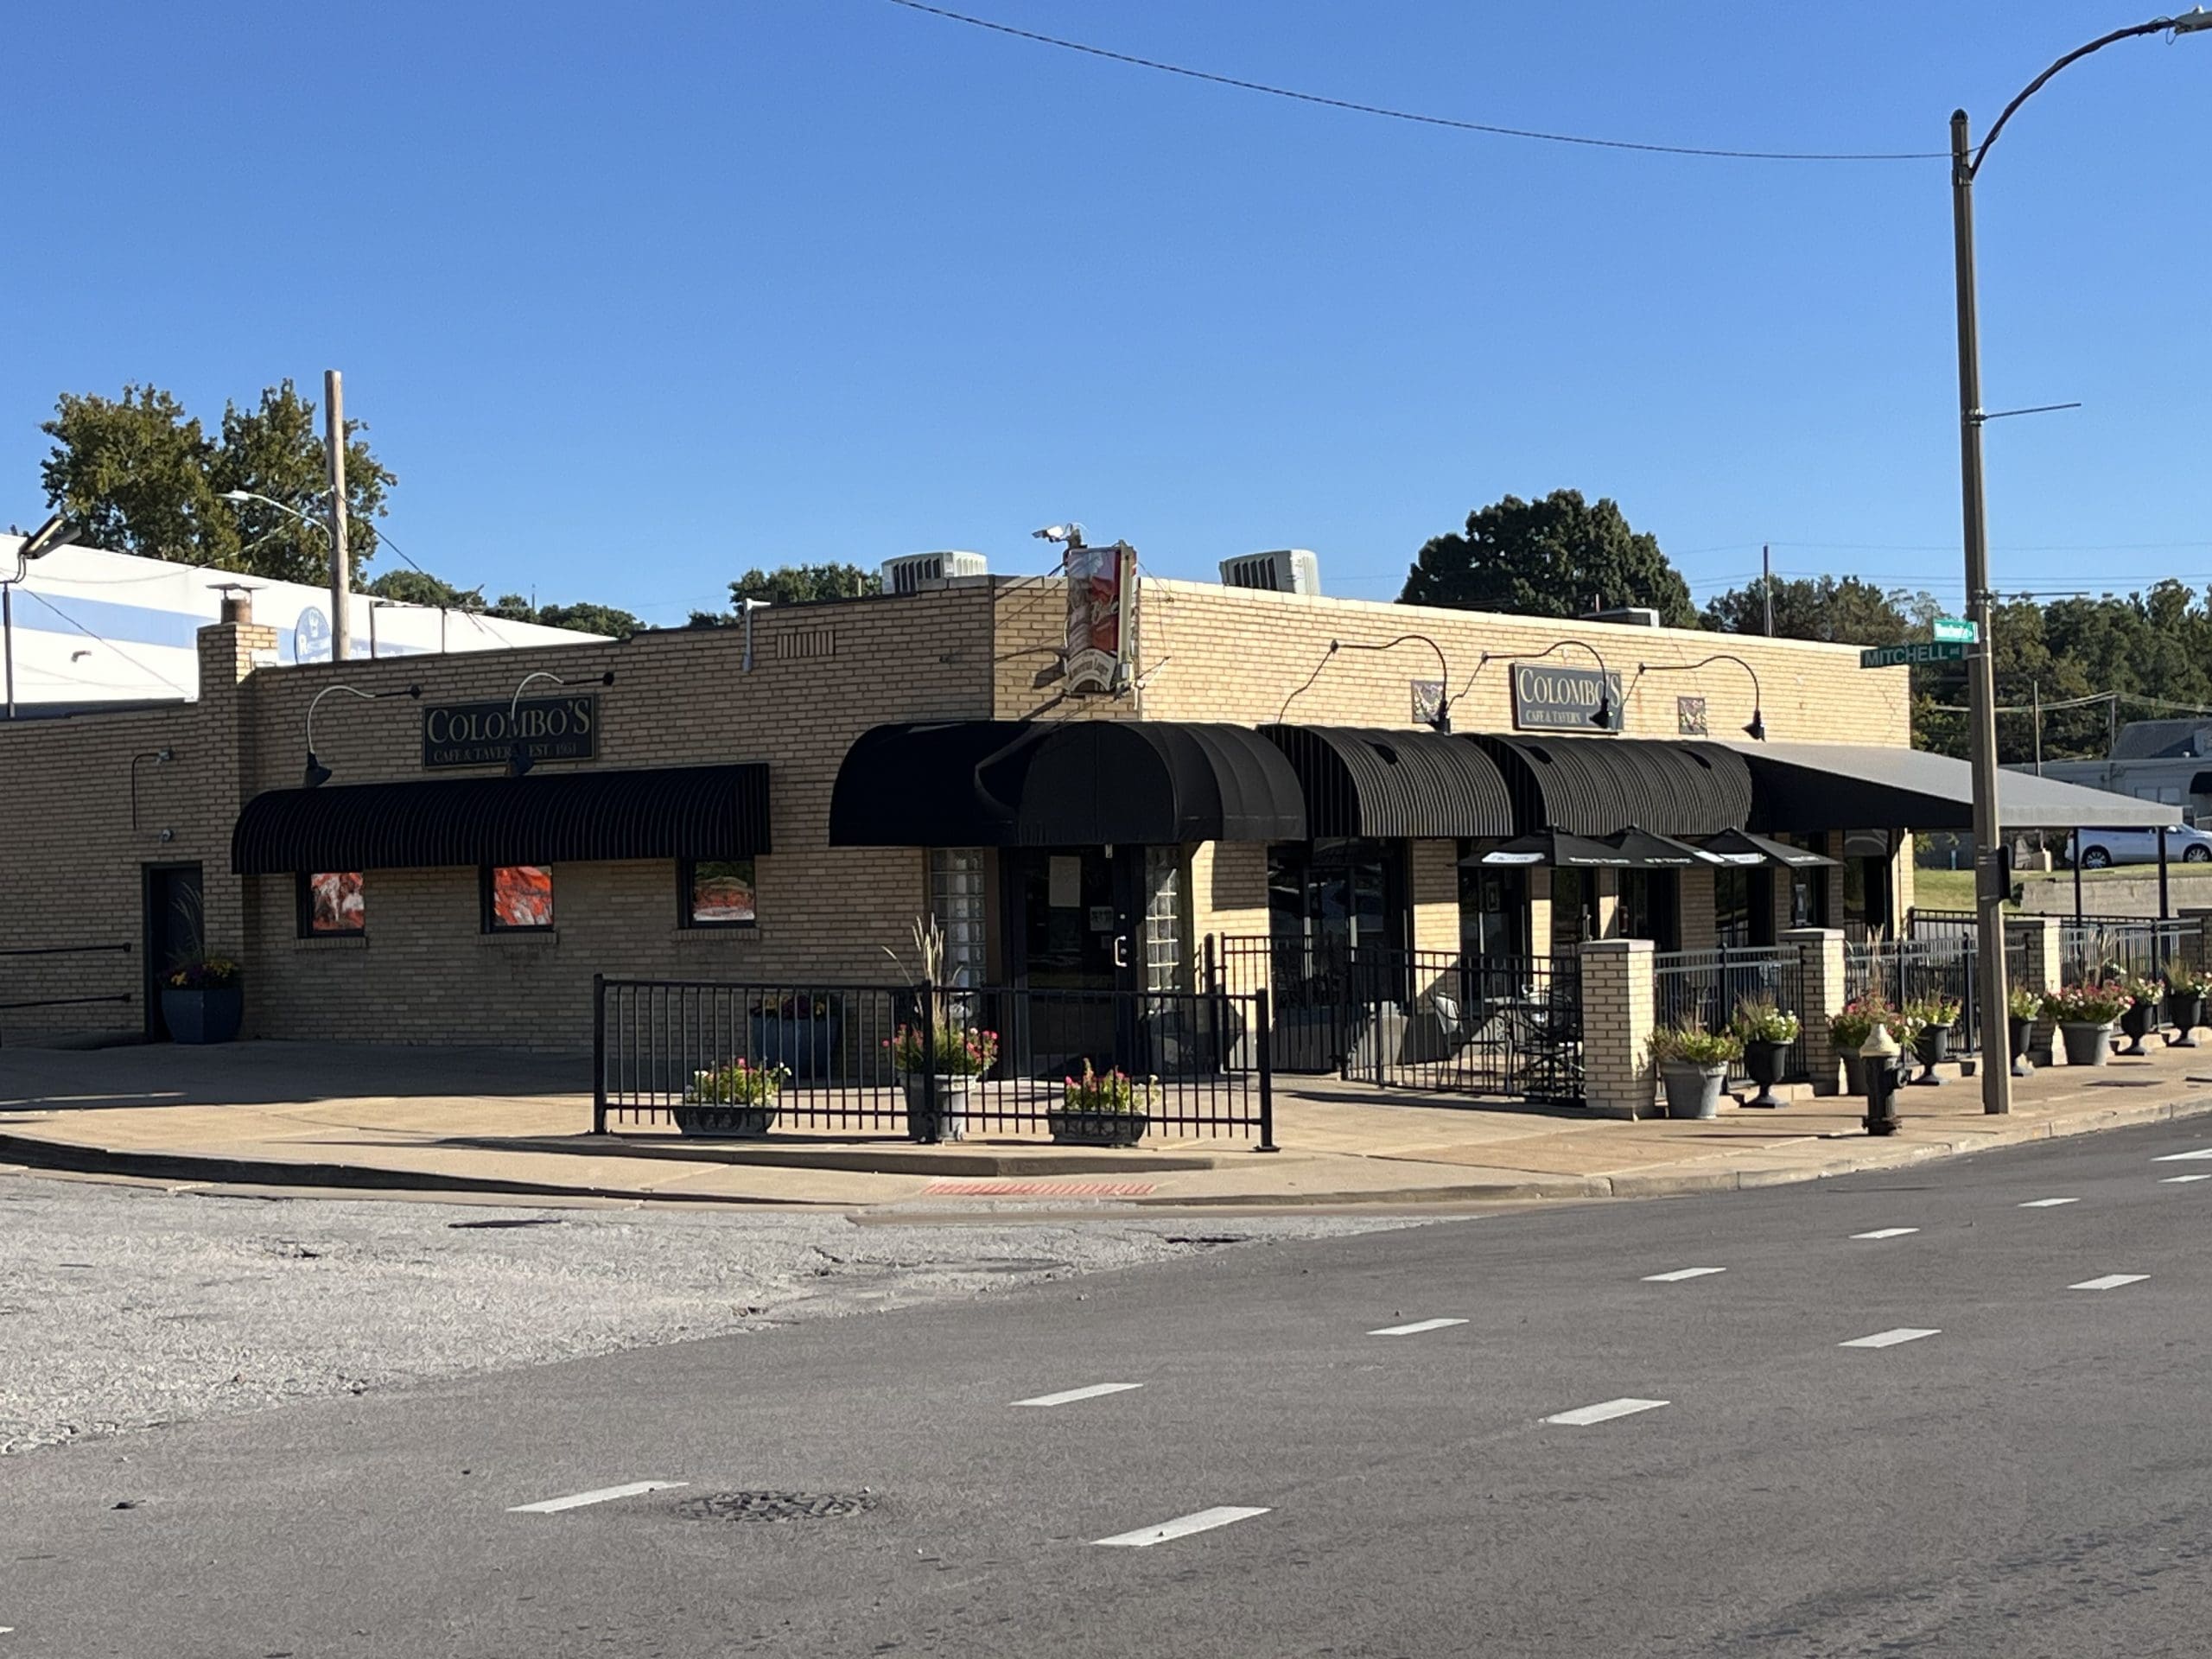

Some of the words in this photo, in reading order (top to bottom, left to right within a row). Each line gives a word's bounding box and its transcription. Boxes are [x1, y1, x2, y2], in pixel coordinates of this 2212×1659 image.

[1865, 645, 1948, 666] MITCHELL
[1519, 669, 1621, 708] COLOMBO'S
[427, 700, 590, 743] COLOMBO'S
[434, 748, 461, 763] CAFE
[473, 746, 512, 761] TAVER
